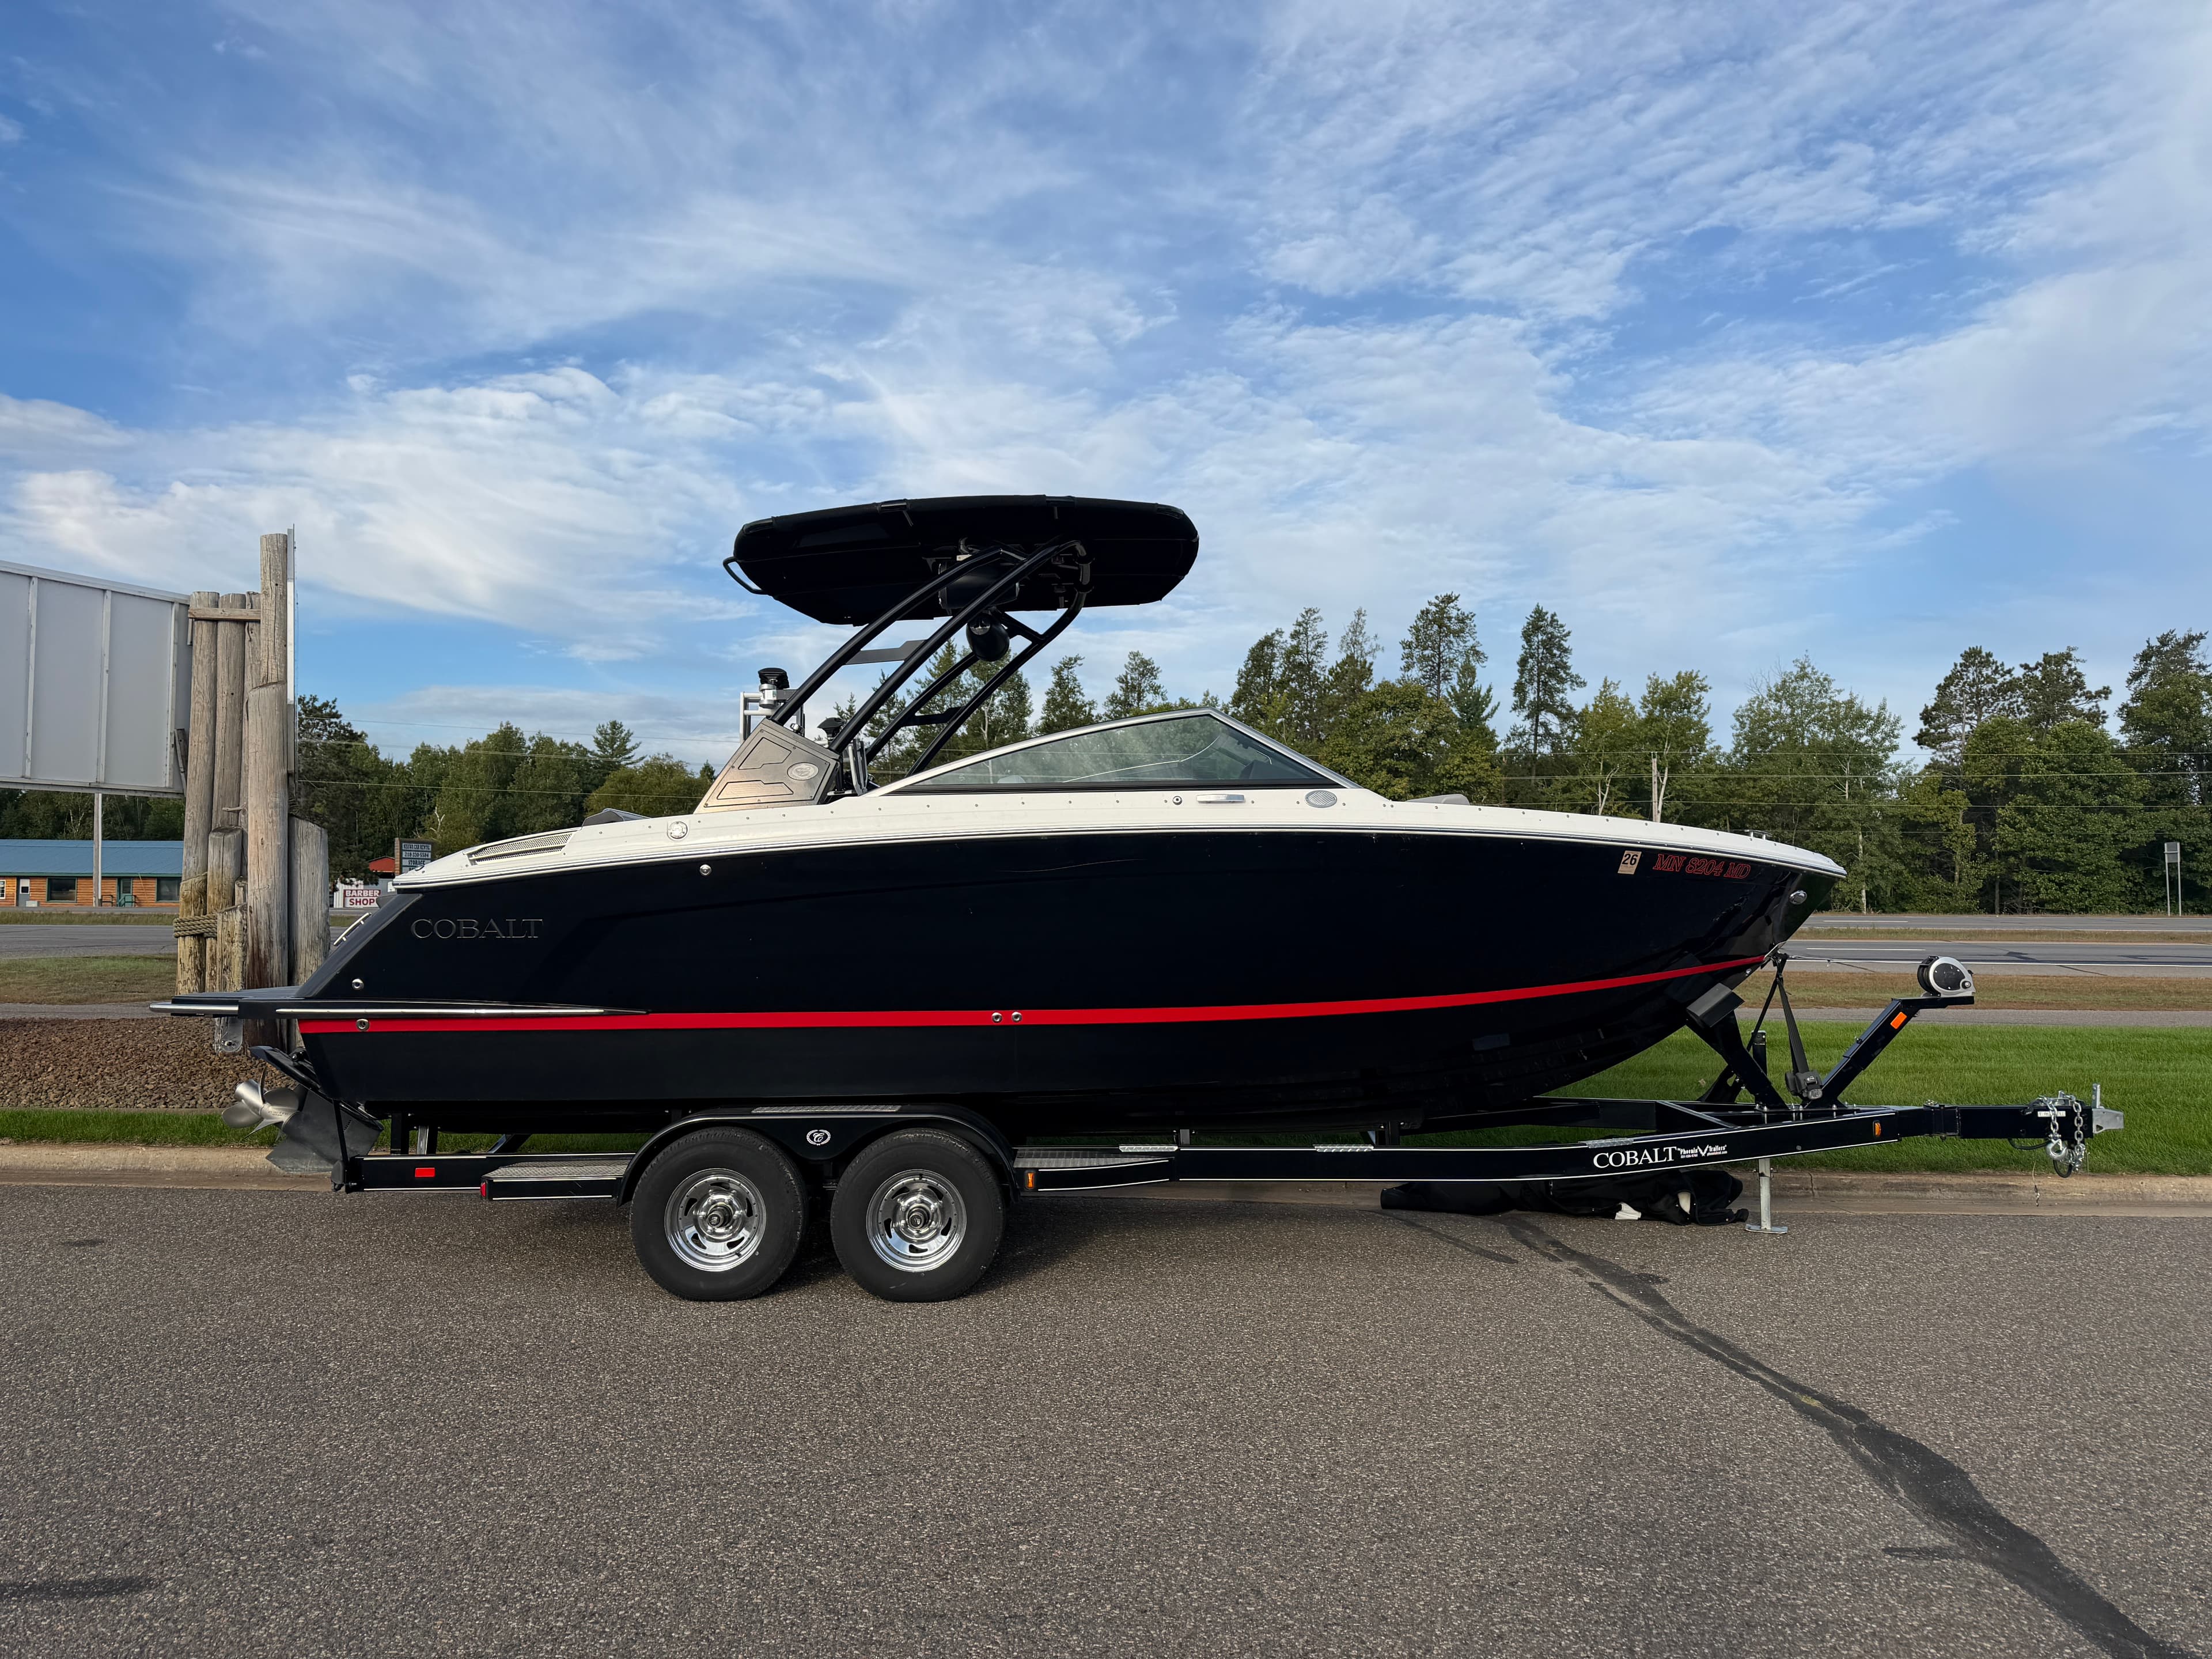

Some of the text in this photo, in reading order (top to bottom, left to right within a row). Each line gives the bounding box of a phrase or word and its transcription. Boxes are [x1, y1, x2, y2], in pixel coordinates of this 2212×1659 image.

[1622, 853, 1638, 866] 26
[1653, 854, 1687, 872] MN
[1685, 857, 1726, 876] 8204
[1724, 862, 1751, 879] MD
[410, 918, 544, 939] COBALT
[1593, 1146, 1677, 1168] COBALT
